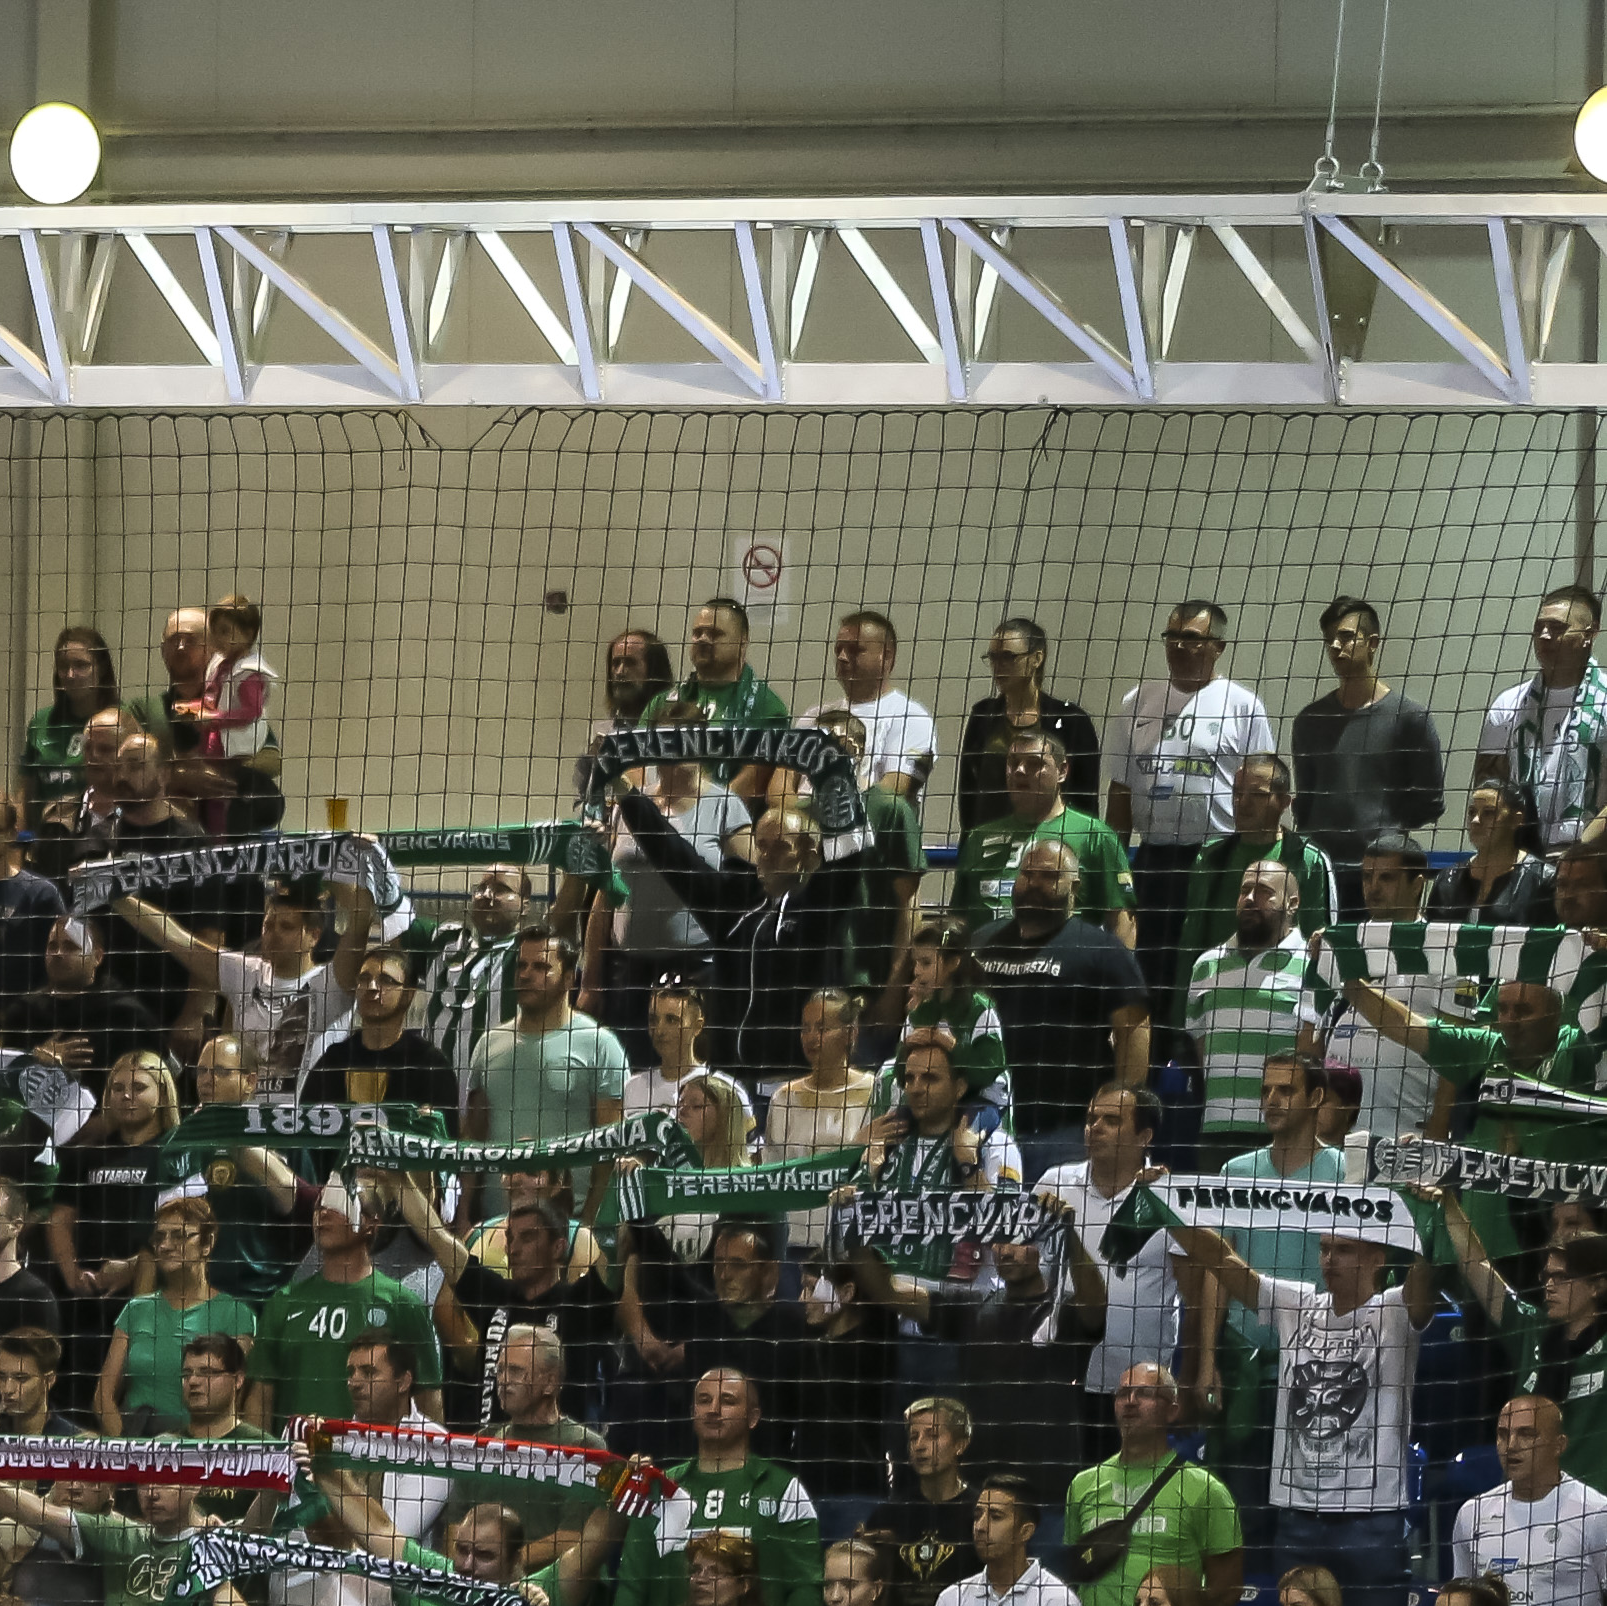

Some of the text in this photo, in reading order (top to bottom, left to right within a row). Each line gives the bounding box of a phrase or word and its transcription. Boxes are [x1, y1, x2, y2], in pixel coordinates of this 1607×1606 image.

[1175, 1186, 1395, 1224] FERENCVAROS
[308, 1305, 347, 1340] 40
[703, 1486, 724, 1520] 8
